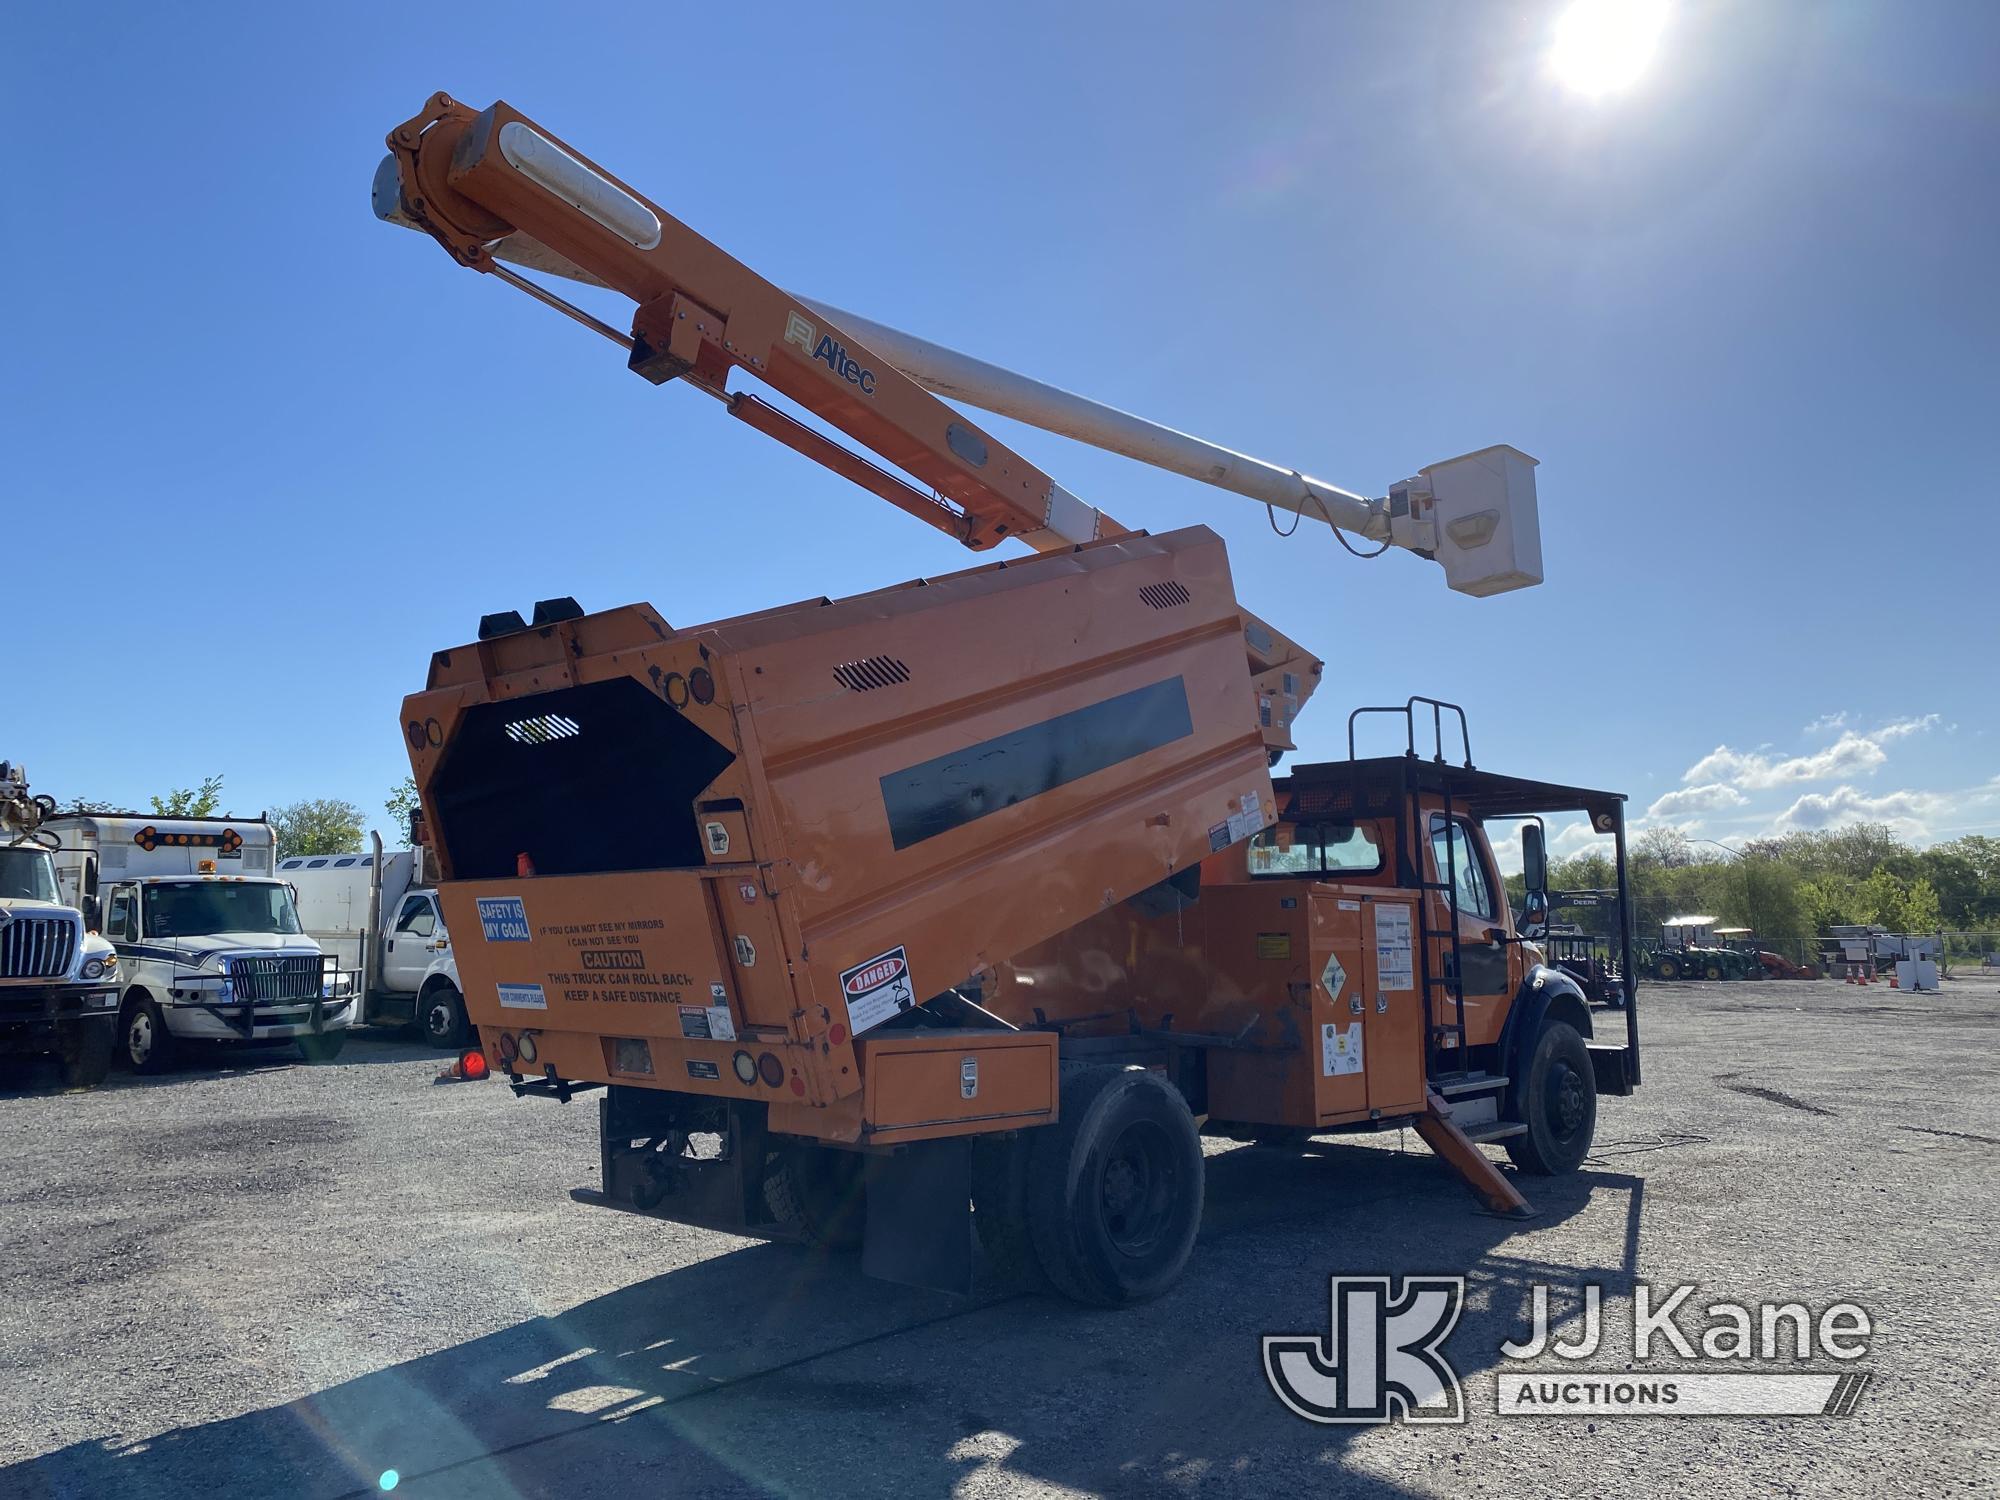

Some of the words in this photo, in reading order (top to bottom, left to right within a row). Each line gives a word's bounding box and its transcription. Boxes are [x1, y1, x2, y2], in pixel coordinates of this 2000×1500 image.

[812, 333, 877, 396] Altec
[479, 903, 512, 919] SAFETY
[512, 903, 523, 919] IS
[485, 922, 499, 938] MY
[501, 922, 529, 938] GOAL
[539, 926, 547, 937] IF
[549, 926, 563, 935] YOU
[564, 925, 580, 934] CAN
[581, 924, 597, 933] NOT
[598, 923, 613, 932] SEE
[614, 922, 626, 931] MY
[628, 919, 665, 930] MIRRORS
[572, 938, 588, 947] CAN
[589, 937, 605, 946] NOT
[607, 936, 622, 945] SEE
[624, 935, 639, 944] YOU
[583, 952, 642, 968] CAUTION
[547, 973, 570, 984] THIS
[572, 973, 607, 984] TRUCK
[609, 973, 630, 985] CAN
[633, 974, 660, 985] ROLL
[855, 960, 897, 991] DANGER
[564, 990, 589, 1001] KEEP
[592, 990, 600, 1001] A
[601, 991, 627, 1002] SAFE
[629, 991, 682, 1003] DISTANCE
